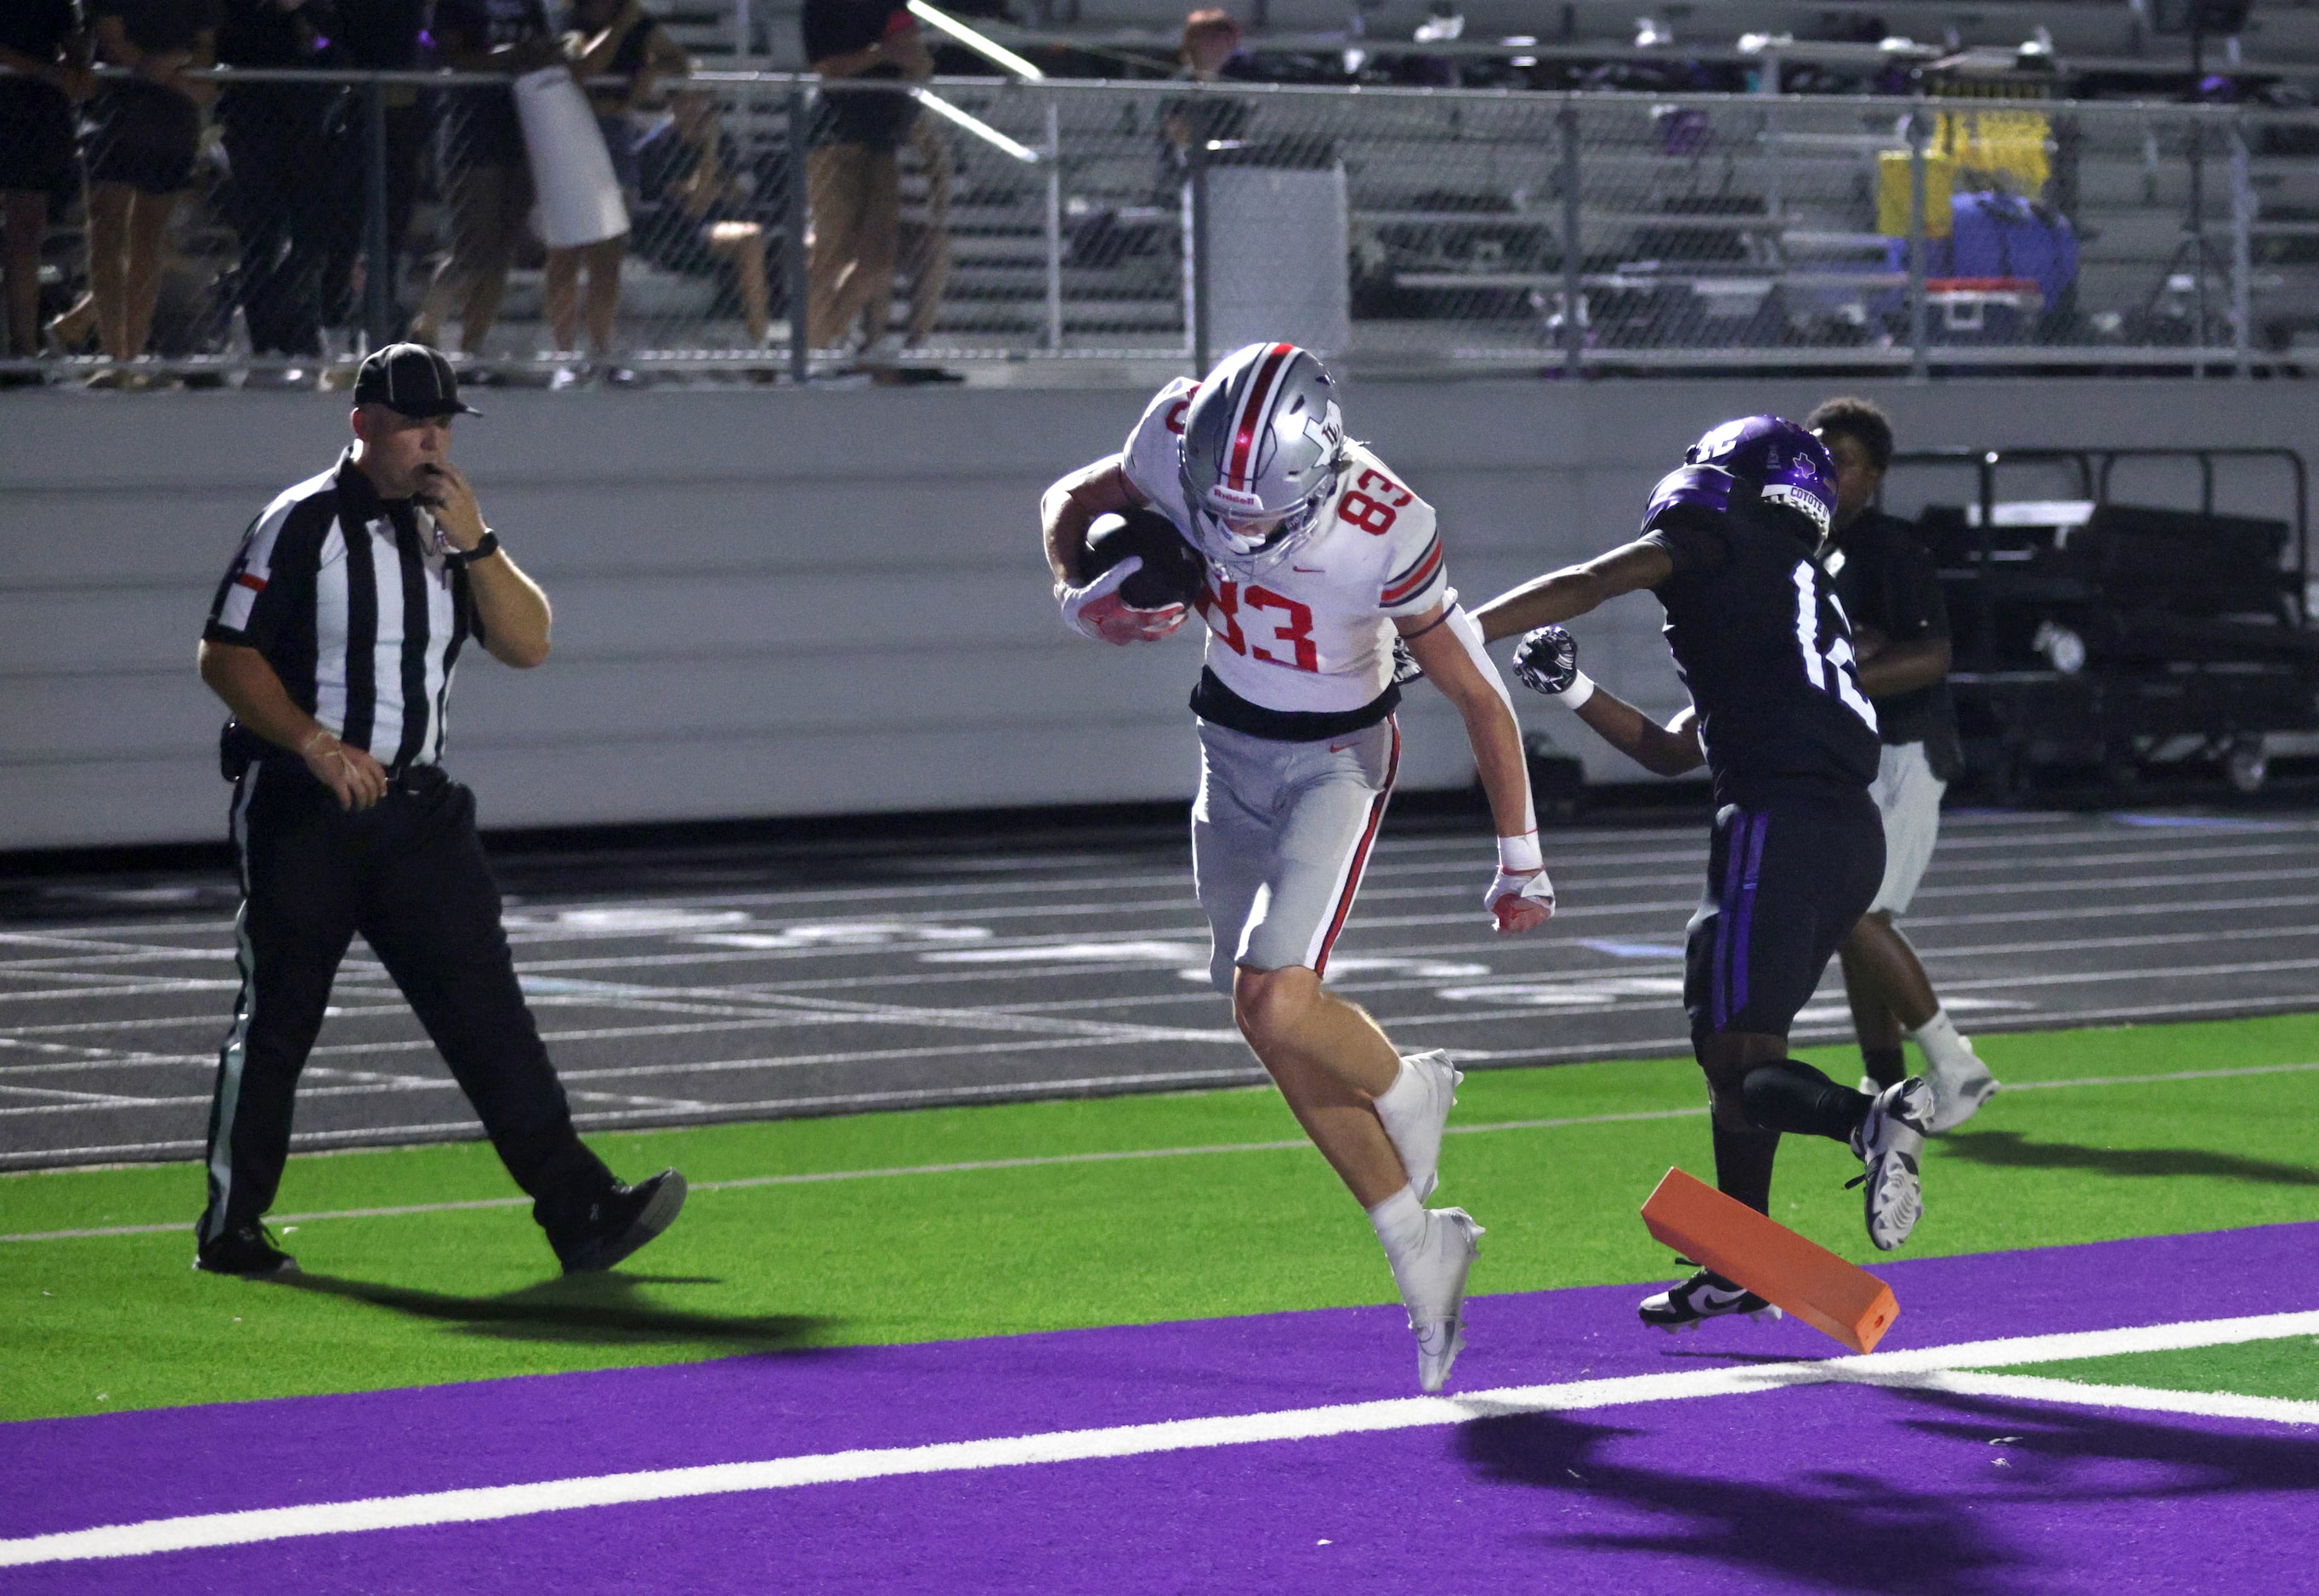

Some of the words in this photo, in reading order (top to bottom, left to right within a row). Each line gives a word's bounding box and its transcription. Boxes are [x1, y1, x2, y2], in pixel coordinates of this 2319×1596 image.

[1214, 489, 1254, 505] Riddell
[1337, 468, 1415, 536] 83
[1790, 487, 1823, 512] COYOTE
[1194, 581, 1318, 673] 83
